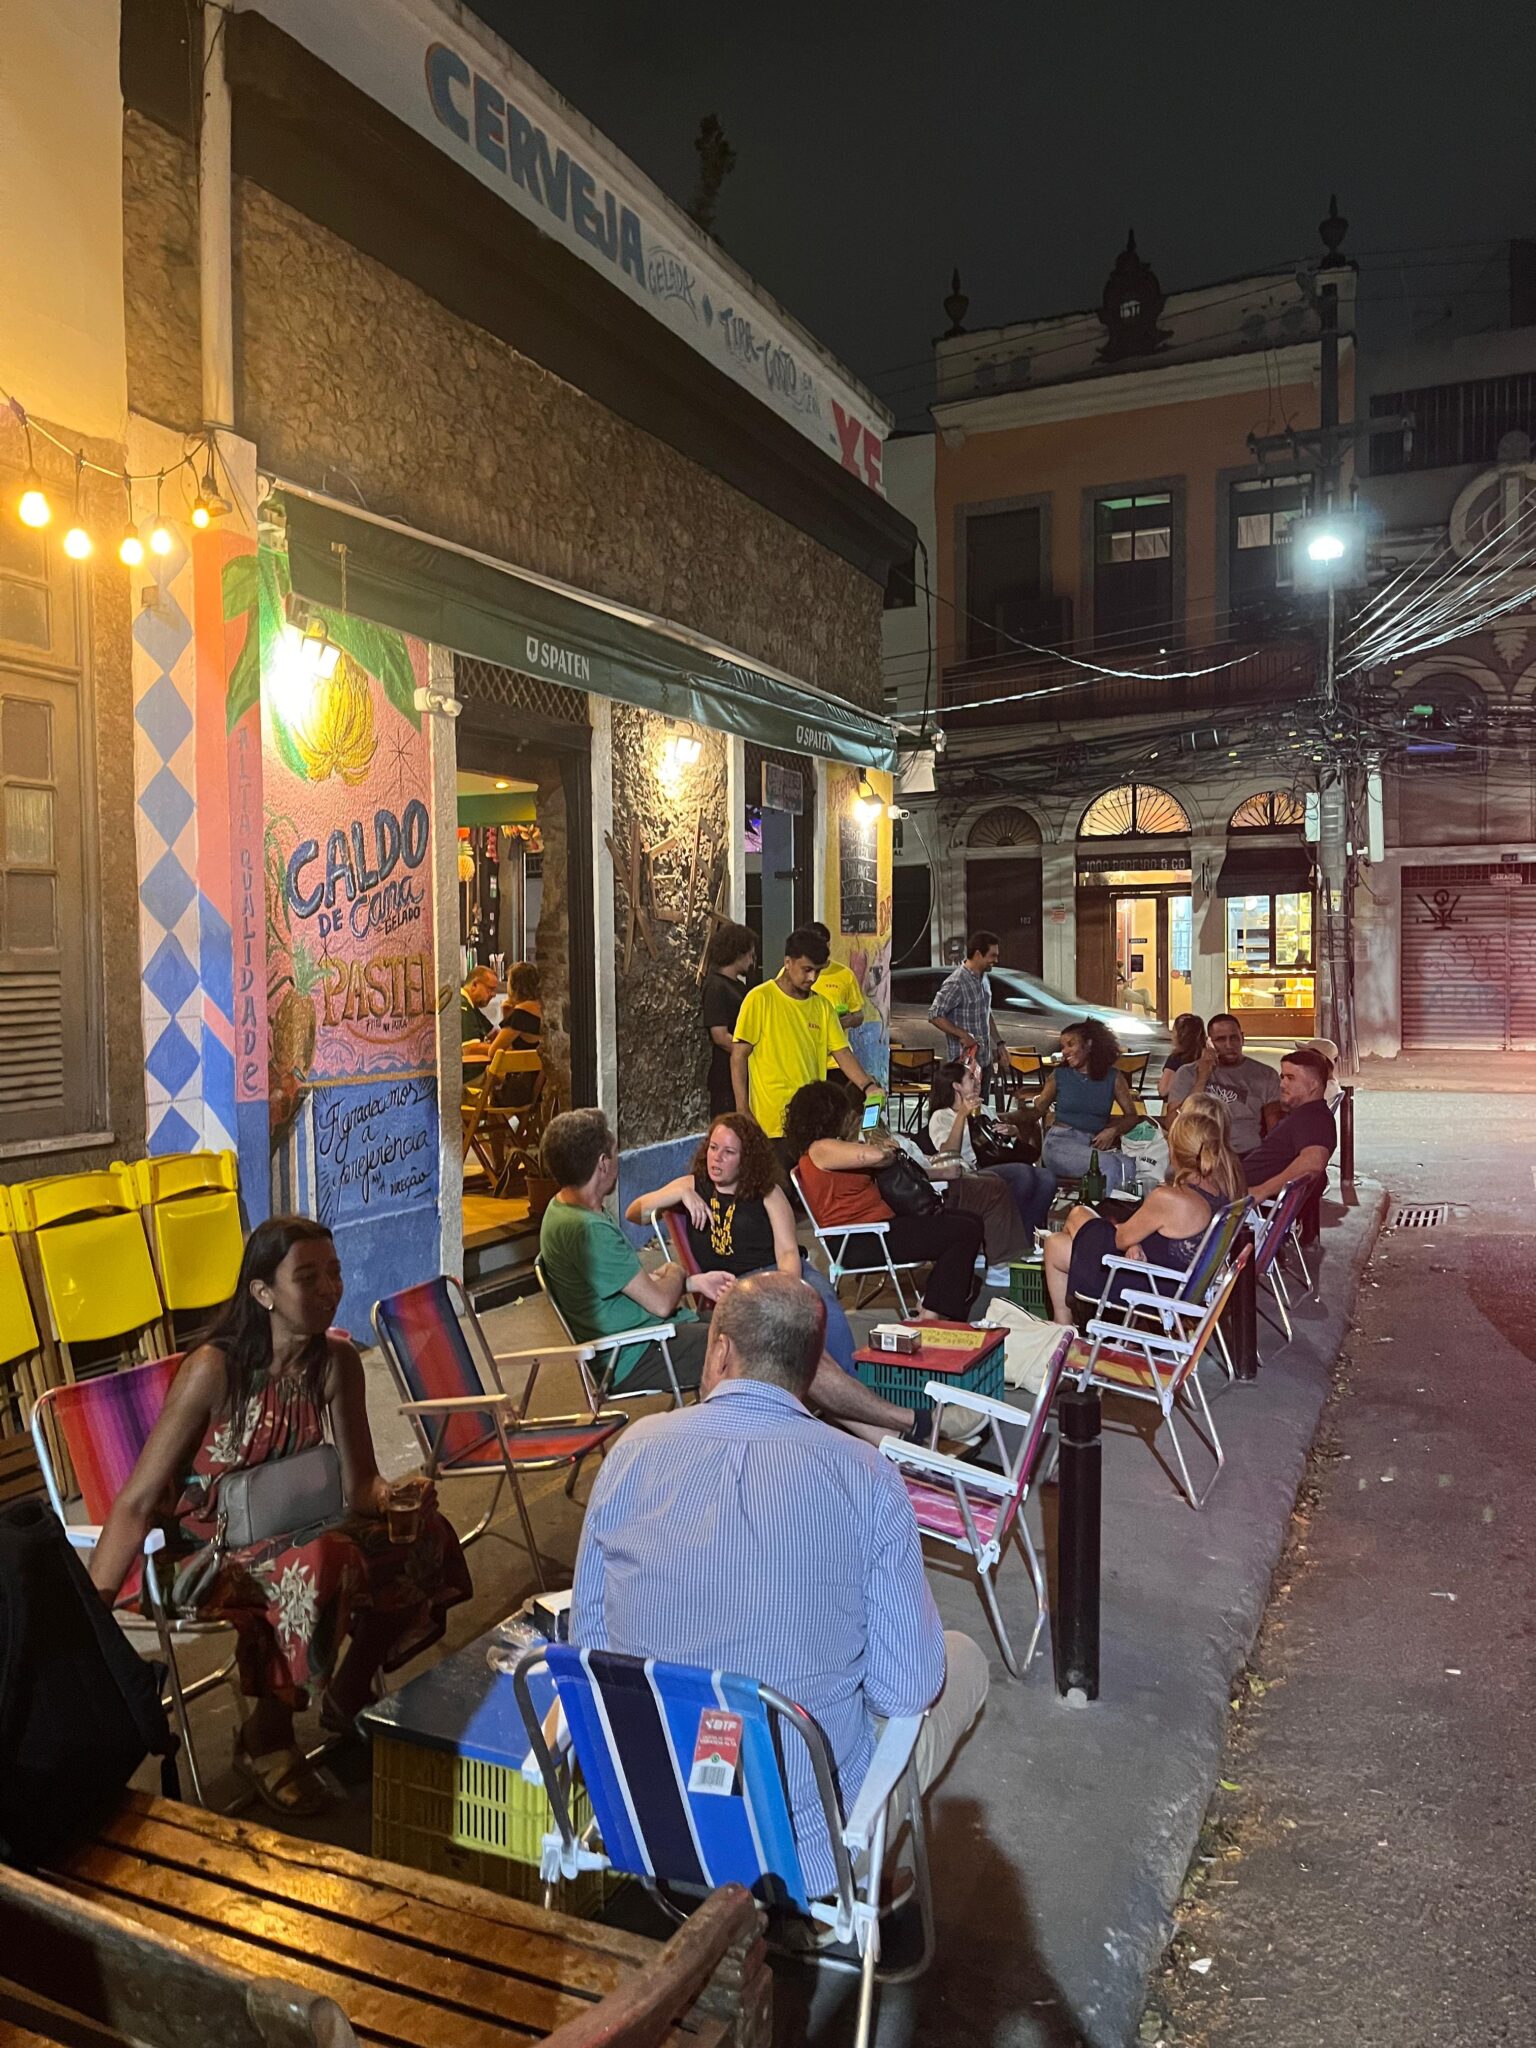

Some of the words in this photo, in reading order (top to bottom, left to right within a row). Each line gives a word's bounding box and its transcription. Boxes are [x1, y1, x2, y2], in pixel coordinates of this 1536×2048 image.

[425, 41, 648, 291] CERVEJA
[648, 255, 696, 310] GELADA
[541, 642, 590, 681] SPATEN
[803, 727, 832, 753] SPATEN
[239, 727, 252, 834] ALTA
[285, 799, 429, 920] CALDO
[1161, 858, 1168, 870] &
[1171, 858, 1186, 870] CO
[318, 908, 343, 938] DE
[384, 905, 421, 936] GELADO
[319, 953, 453, 1027] PASTEL
[319, 1082, 434, 1164] Agradecemos
[362, 1125, 379, 1143] a
[333, 1129, 432, 1212] preferência
